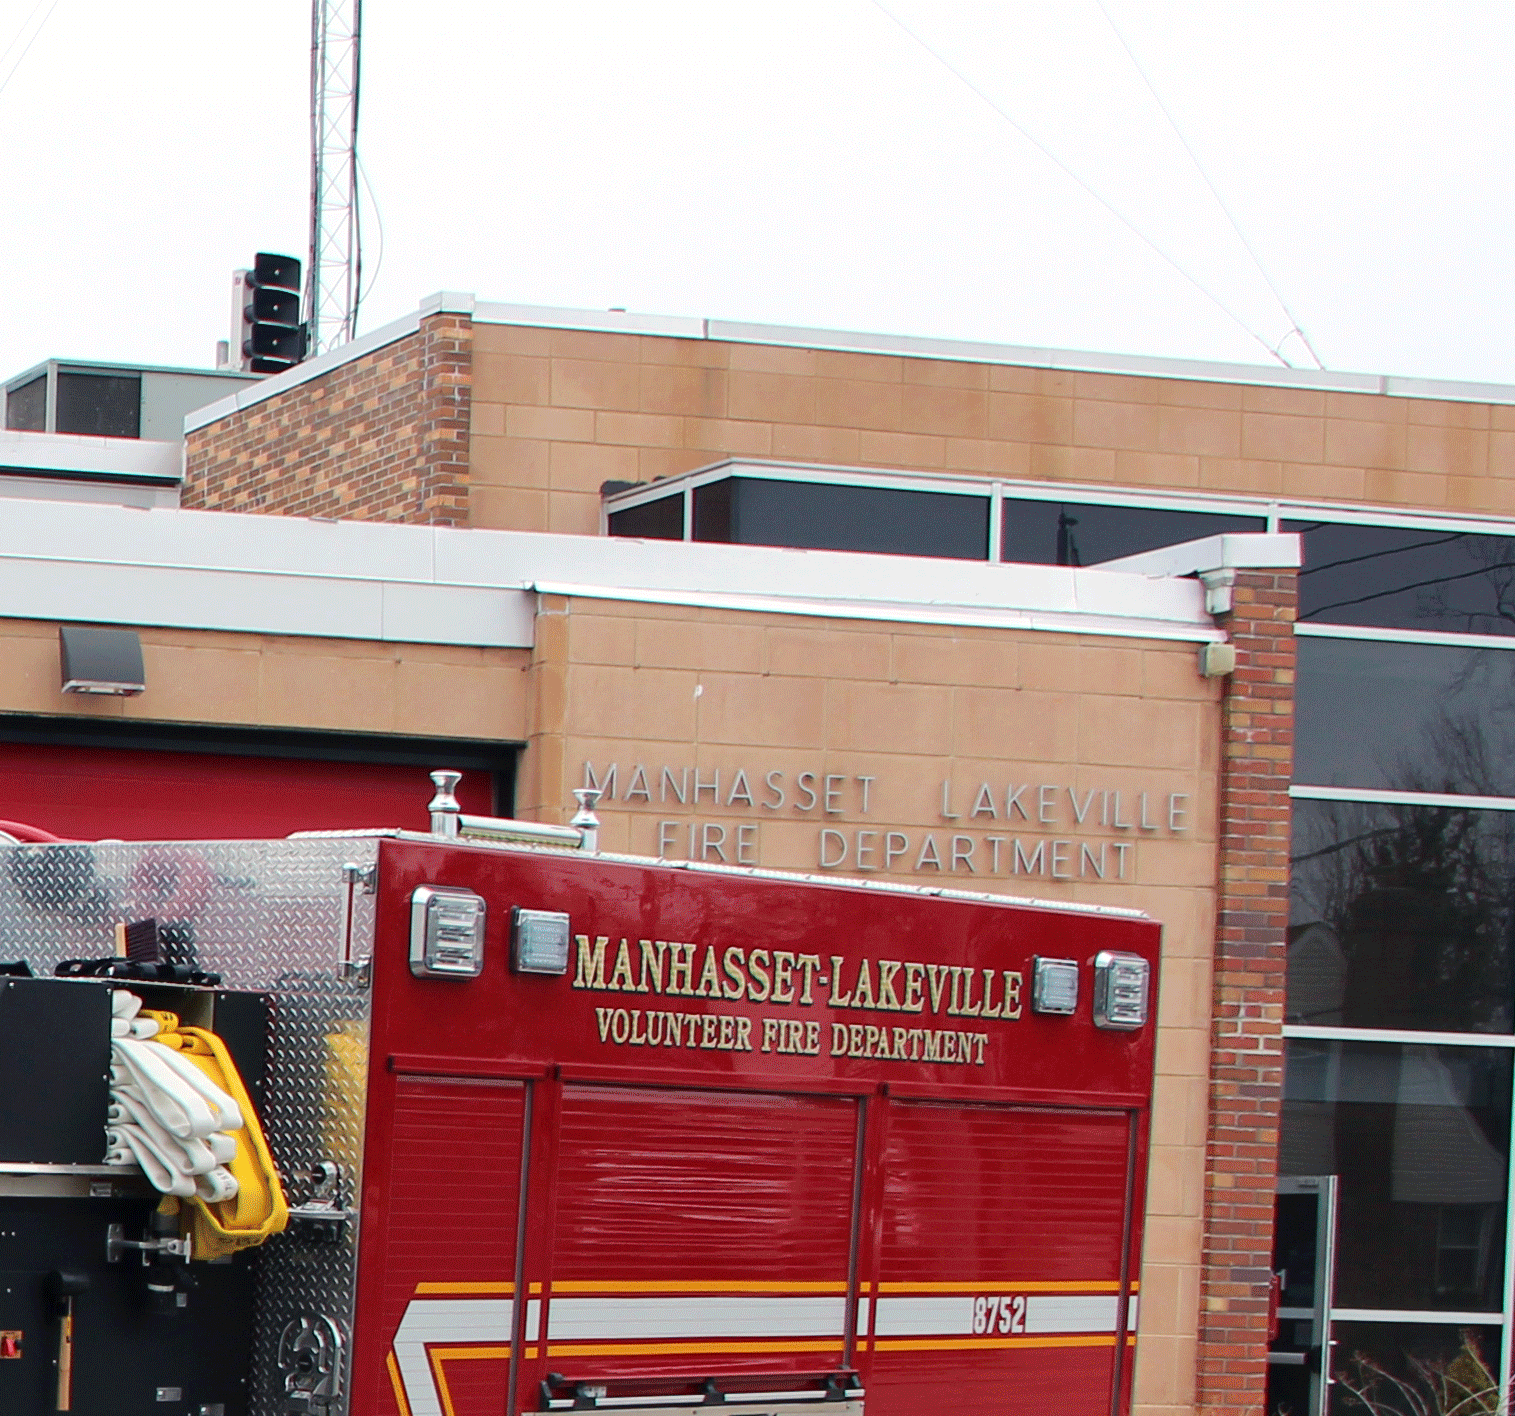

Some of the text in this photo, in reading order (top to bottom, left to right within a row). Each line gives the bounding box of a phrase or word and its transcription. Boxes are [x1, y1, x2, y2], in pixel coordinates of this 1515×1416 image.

[583, 761, 1190, 832] MANHASSET LAKEVILLE
[658, 821, 1133, 880] FIRE DEPARTMENT
[572, 935, 1023, 1020] MANHASSET-LAKEVILLE
[595, 1007, 989, 1065] VOLUNTEER FIRE DEPARTMENT
[973, 1296, 1025, 1335] 8752
